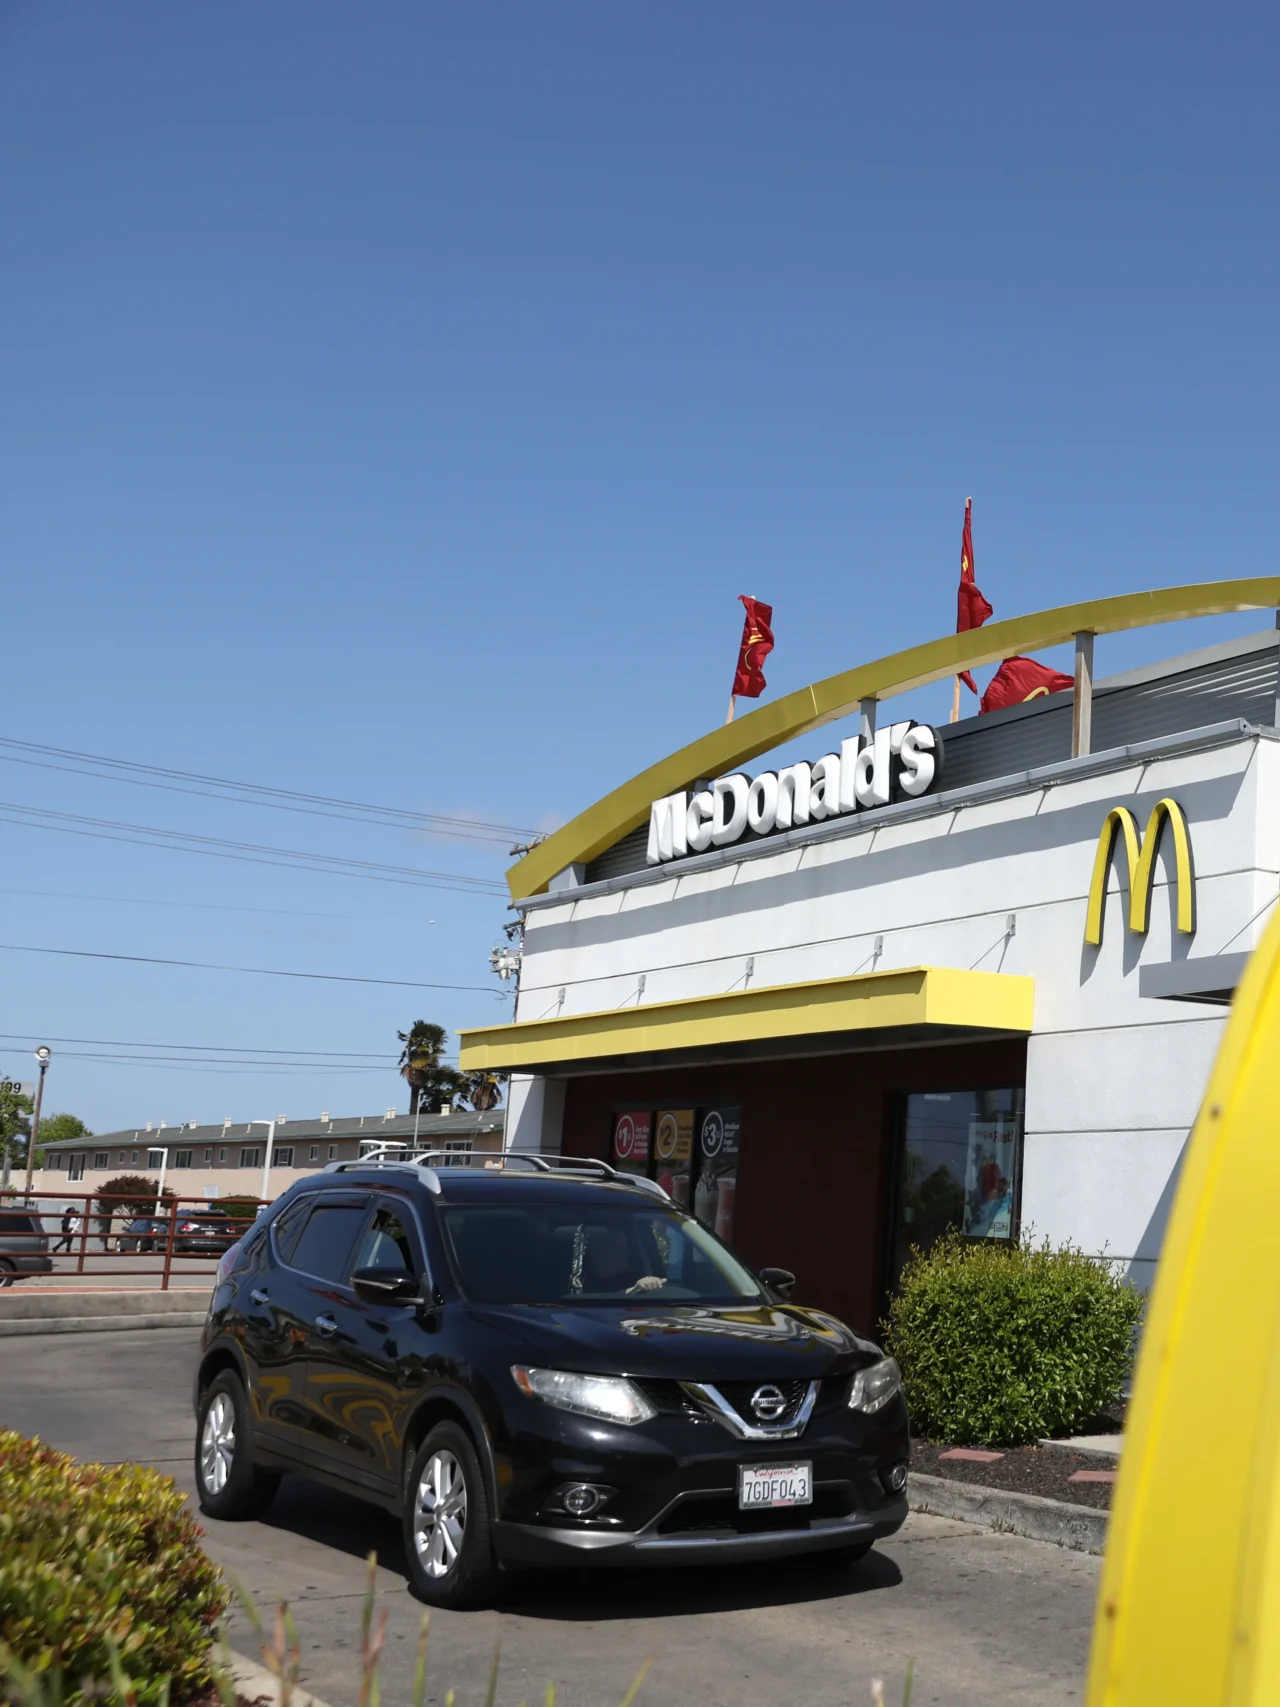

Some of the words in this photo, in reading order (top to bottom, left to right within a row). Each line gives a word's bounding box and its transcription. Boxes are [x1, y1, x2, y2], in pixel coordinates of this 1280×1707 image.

[646, 719, 941, 866] McDonald's
[754, 1468, 798, 1478] California
[745, 1478, 807, 1501] 7GDF043
